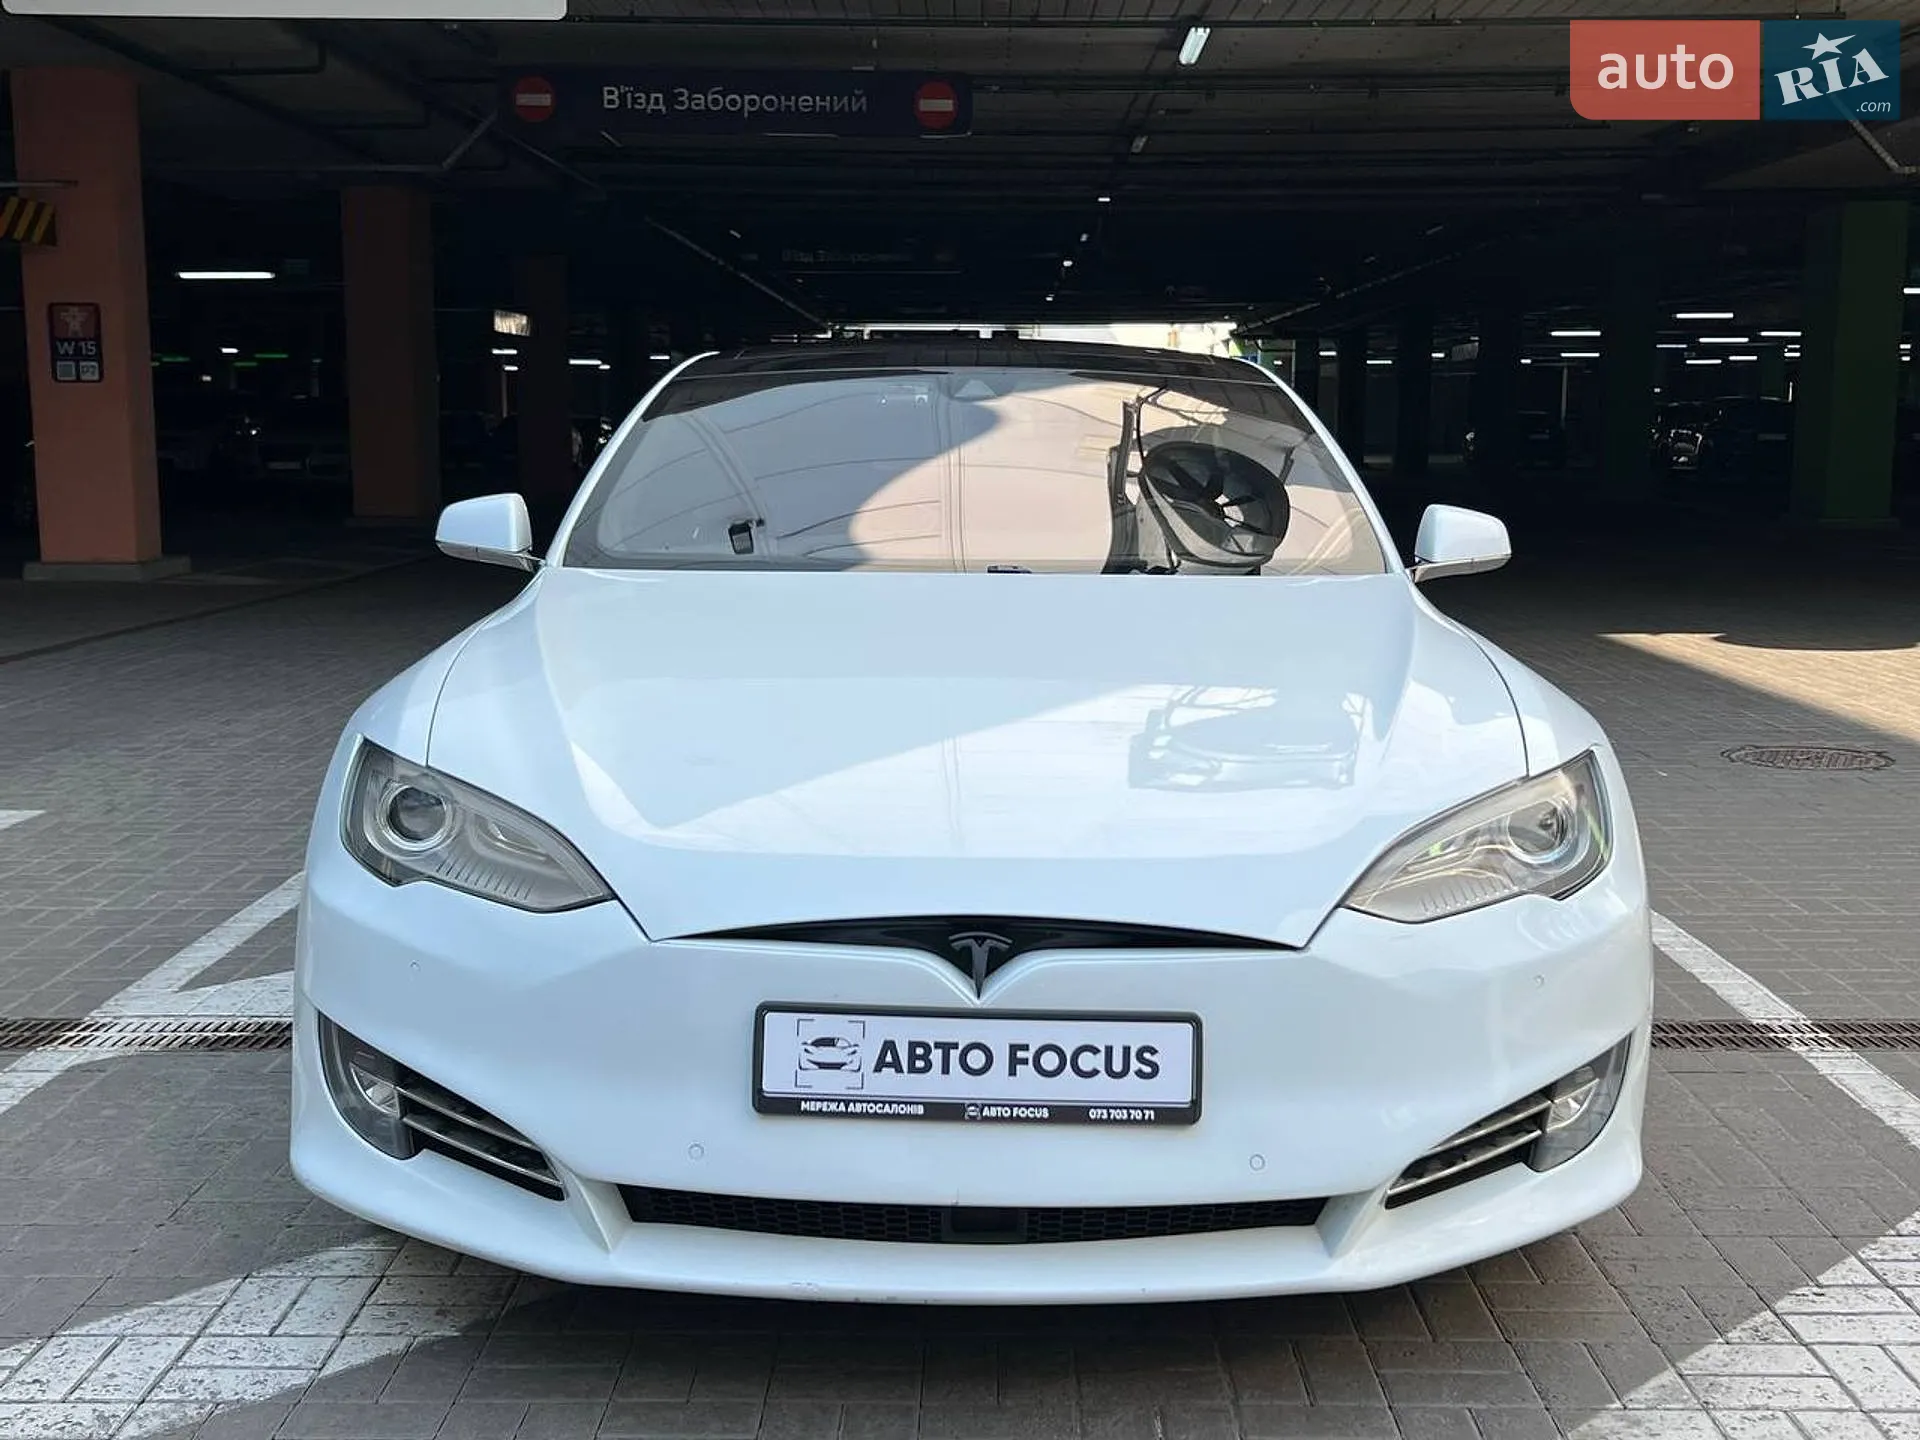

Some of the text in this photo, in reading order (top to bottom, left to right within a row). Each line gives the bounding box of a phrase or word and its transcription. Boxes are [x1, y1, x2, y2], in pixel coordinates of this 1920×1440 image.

[602, 85, 868, 118] В'їзд Заборонений
[55, 340, 98, 356] W 15
[1007, 1043, 1160, 1080] FOCUS
[800, 1100, 925, 1116] МЕРЕЖА АВТОСАЛОНІВ
[1012, 1107, 1050, 1118] FOCUS
[1088, 1109, 1155, 1121] 073 703 70 71
